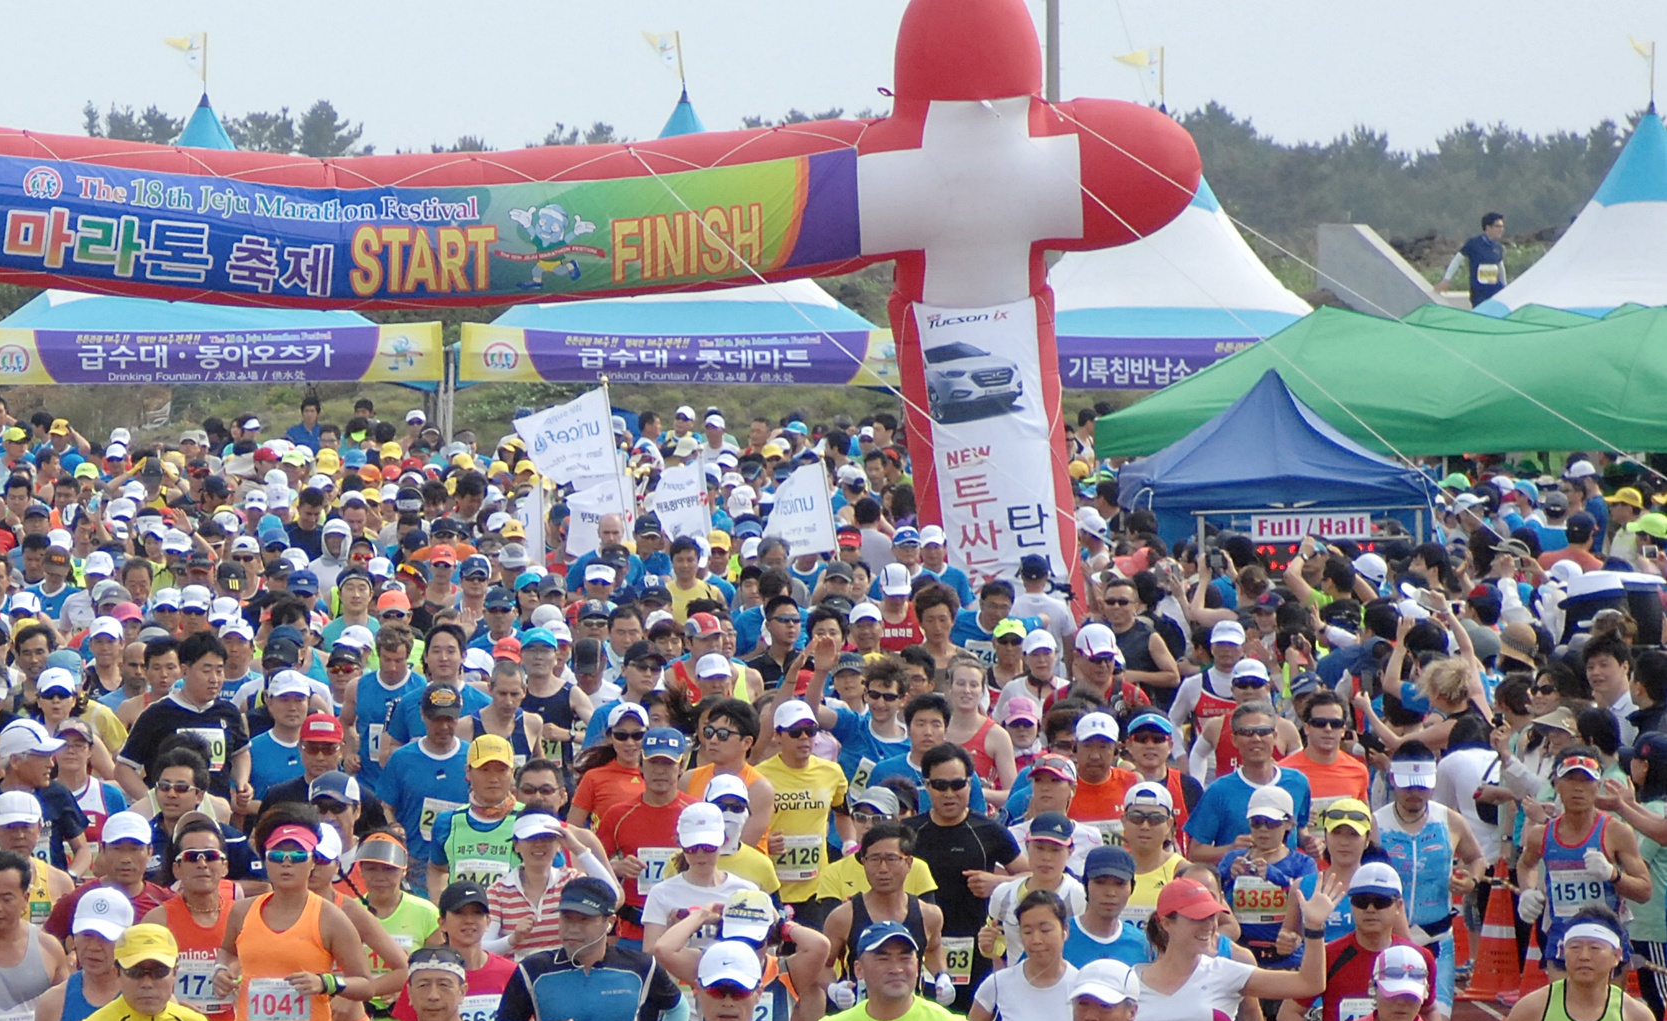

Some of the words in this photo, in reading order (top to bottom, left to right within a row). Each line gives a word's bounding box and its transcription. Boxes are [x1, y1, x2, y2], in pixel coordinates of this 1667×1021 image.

[77, 175, 128, 203] The
[130, 178, 192, 211] 18th
[199, 184, 251, 220] Jeju
[253, 194, 378, 222] Marathon
[381, 196, 479, 221] Festival
[3, 206, 213, 284] 마라톤
[226, 233, 335, 299] 축제
[610, 202, 764, 283] FINISH
[349, 224, 498, 298] START
[928, 314, 989, 329] Tucson
[993, 310, 1010, 320] ix
[77, 344, 168, 369] 급수대
[195, 343, 335, 369] 동아오츠카
[578, 347, 668, 369] 급수대
[695, 348, 812, 370] 롯데마트
[108, 371, 152, 382] Drinking
[156, 371, 201, 381] Fountain
[644, 371, 690, 381] Fountain
[1068, 356, 1192, 385] 기록칩반납소
[946, 445, 991, 467] NEW
[952, 473, 1003, 566] 투싼
[1257, 519, 1300, 536] Full
[1319, 517, 1365, 535] Half
[773, 802, 802, 813] your
[804, 802, 824, 811] run
[456, 844, 476, 856] 제주
[489, 844, 509, 857] 경찰
[1235, 887, 1286, 909] 3355
[1554, 882, 1602, 902] 1519
[250, 993, 304, 1017] 1041
